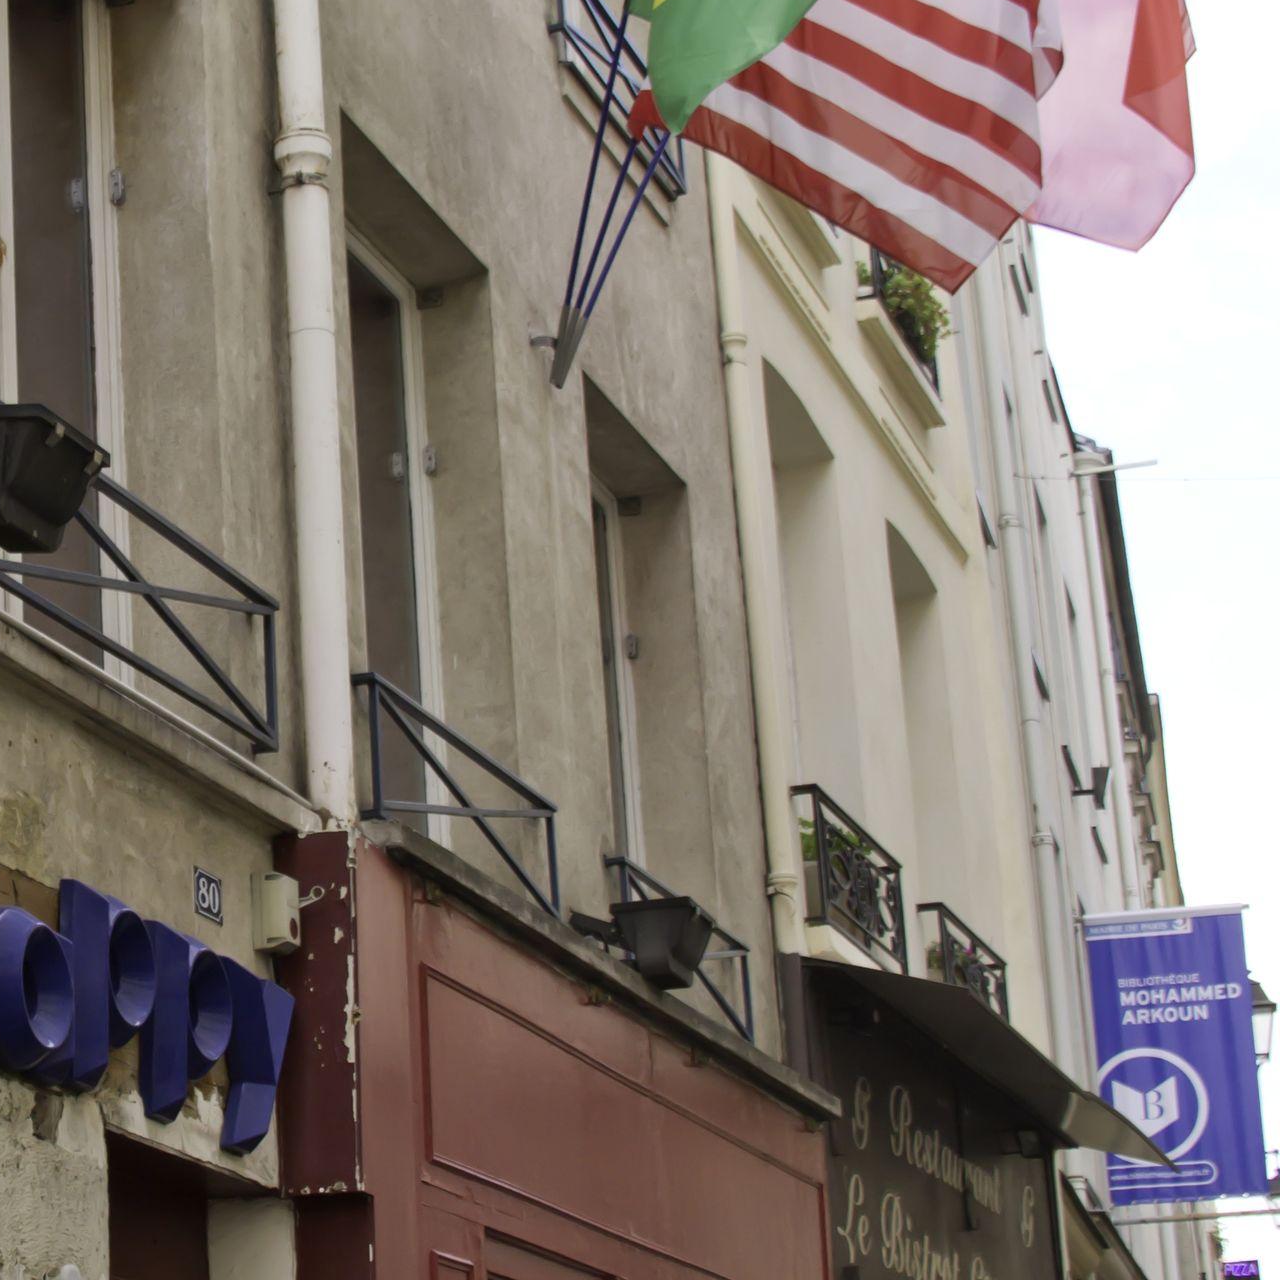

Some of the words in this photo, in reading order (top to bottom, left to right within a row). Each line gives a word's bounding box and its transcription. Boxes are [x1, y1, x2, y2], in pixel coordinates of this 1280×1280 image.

[198, 877, 220, 914] 80
[1120, 982, 1242, 1007] MOHAMMED
[1122, 1003, 1210, 1026] ARKOUN
[889, 1084, 1001, 1215] Restaurant
[836, 1173, 871, 1264] Le
[1224, 1263, 1258, 1278] PIZZA
